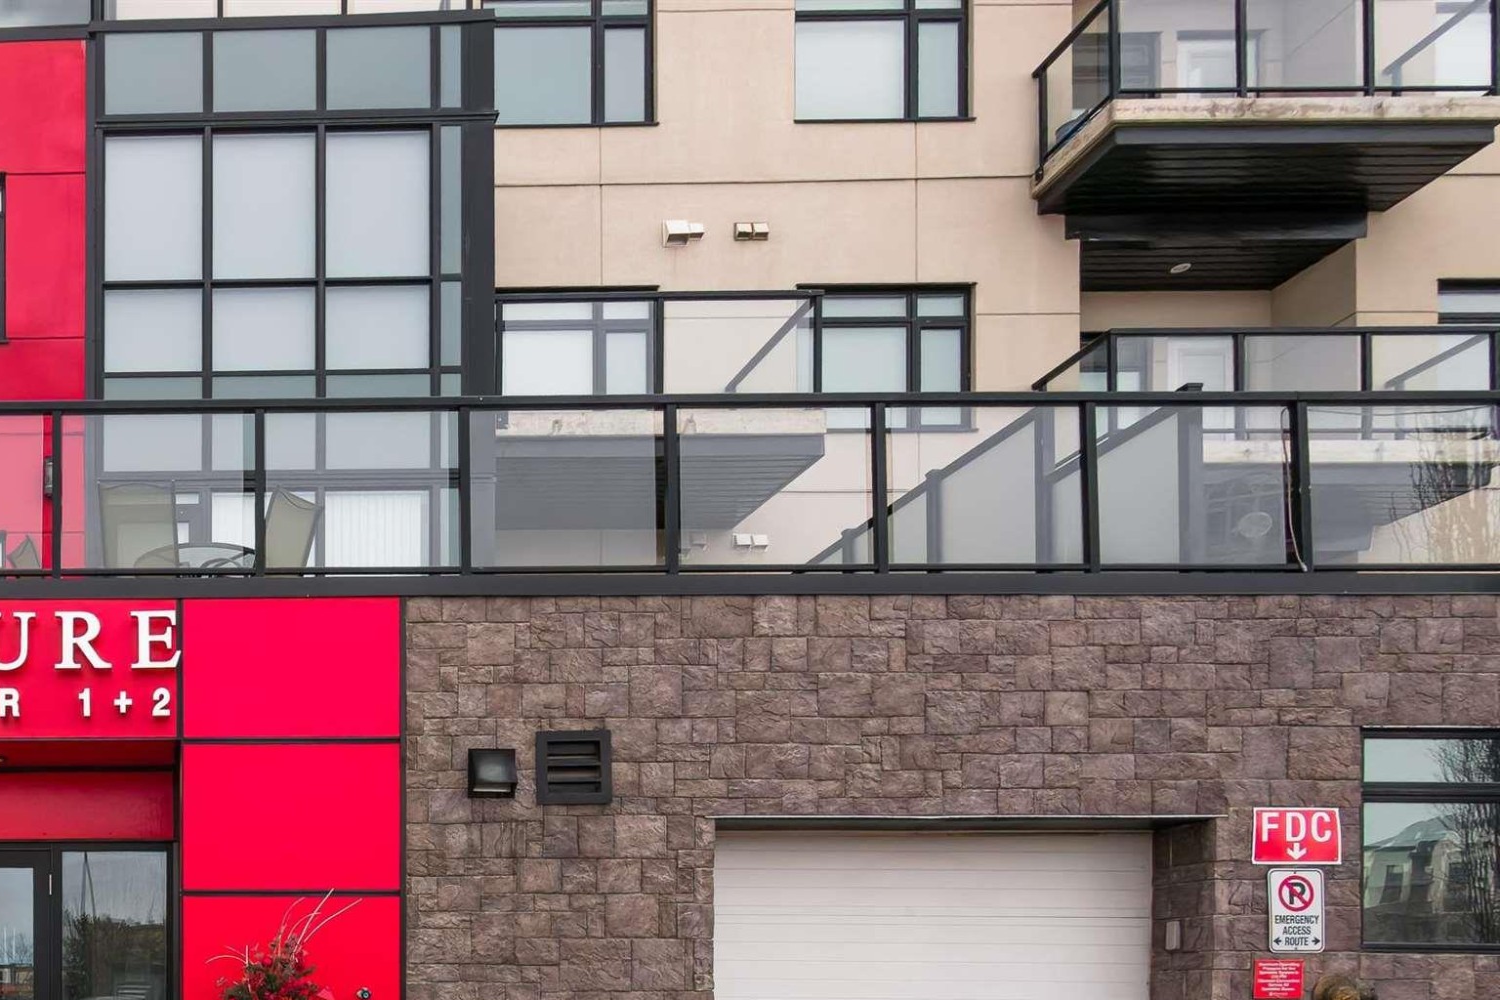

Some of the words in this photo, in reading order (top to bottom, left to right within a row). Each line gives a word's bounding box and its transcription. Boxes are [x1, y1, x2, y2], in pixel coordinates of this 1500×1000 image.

[77, 687, 172, 717] 1+2
[1261, 812, 1331, 842] FDC
[1275, 915, 1320, 924] EMERGENCY
[1282, 926, 1311, 935] ACCESS
[1284, 937, 1309, 946] ROUTE
